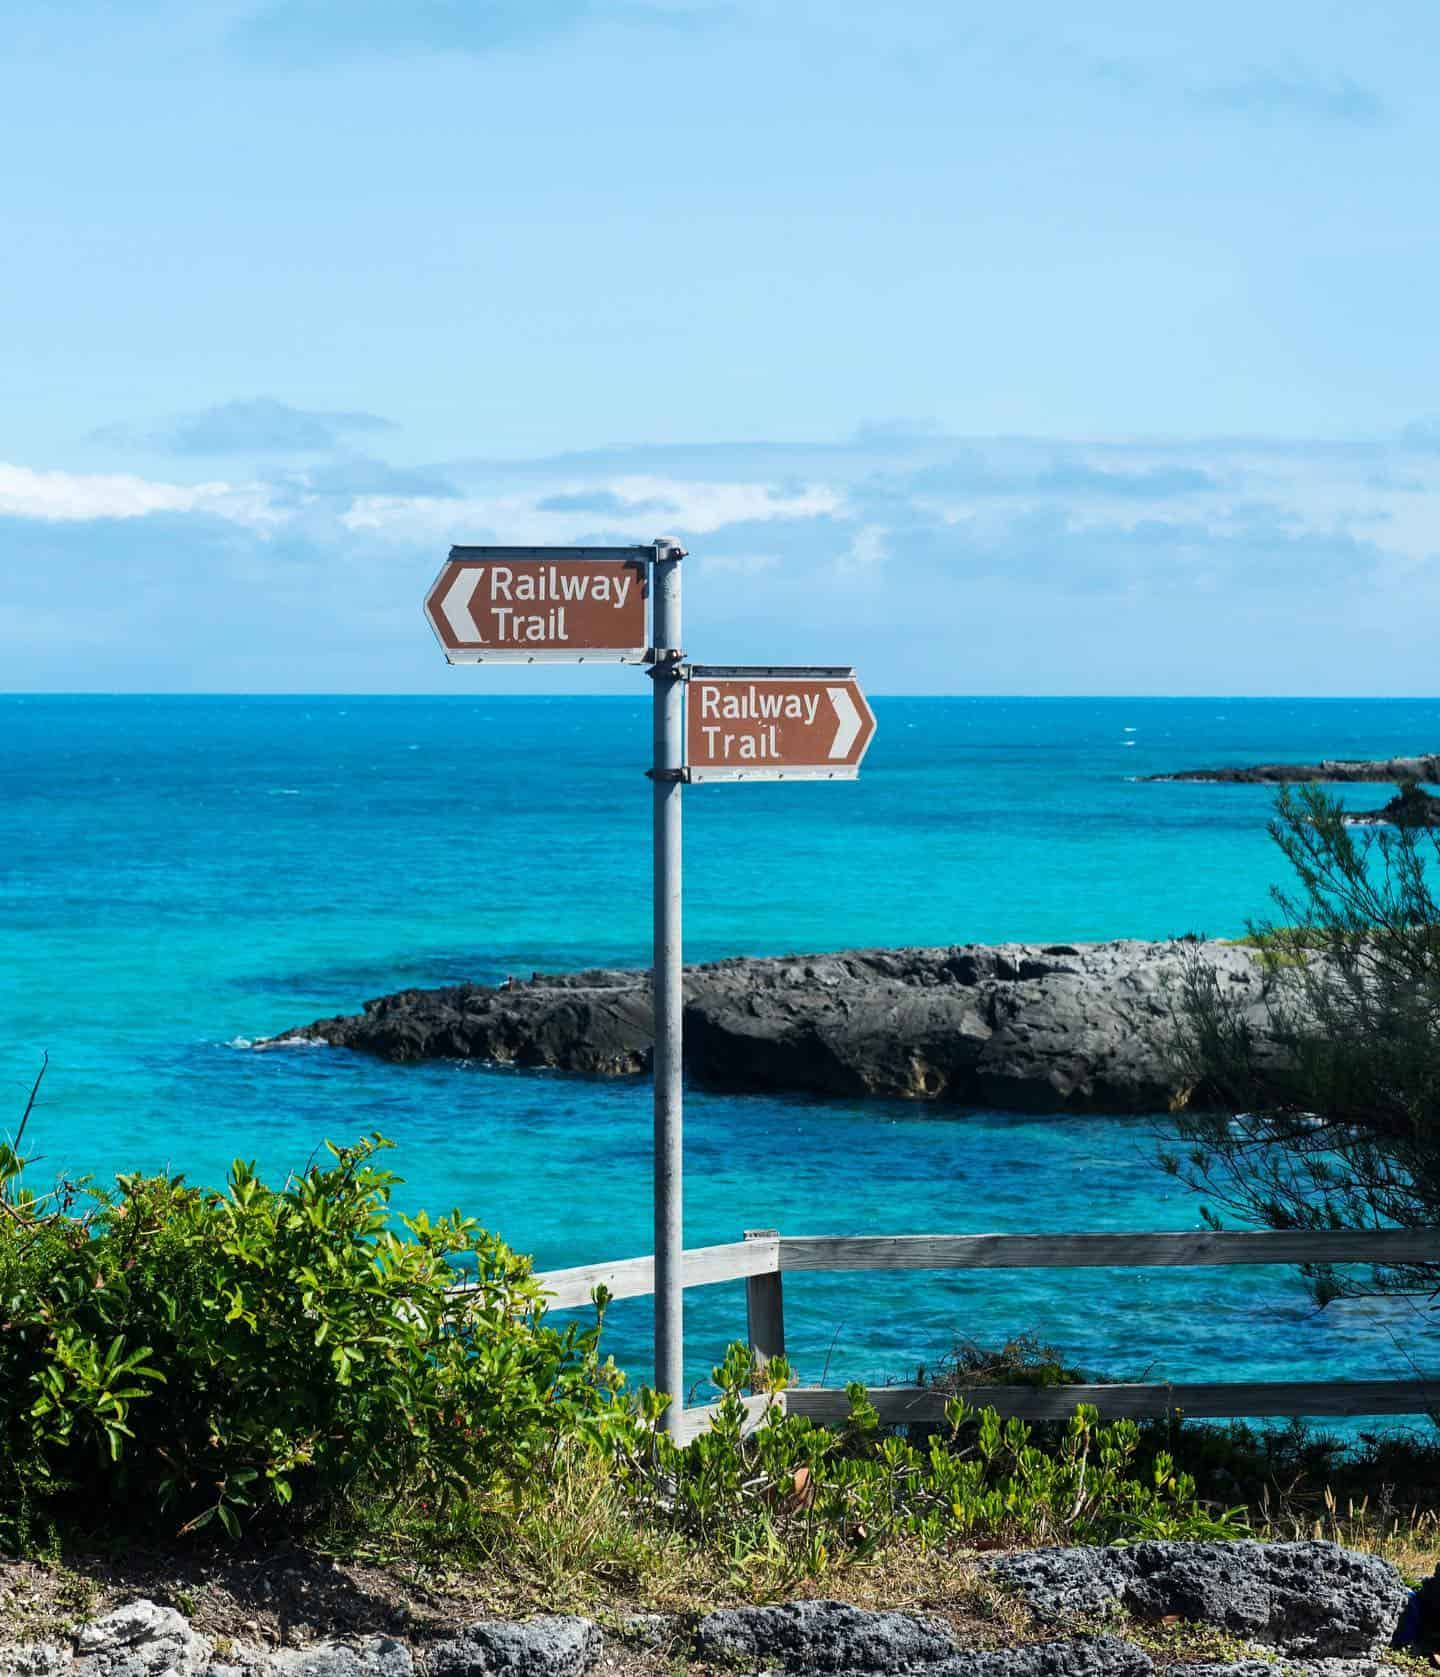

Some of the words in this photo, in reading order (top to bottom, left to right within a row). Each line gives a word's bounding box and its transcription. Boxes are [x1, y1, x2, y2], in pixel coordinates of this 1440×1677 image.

[490, 566, 631, 609] Railway
[490, 607, 569, 641] Trail
[701, 685, 820, 726] Railway
[701, 725, 781, 759] Trail
